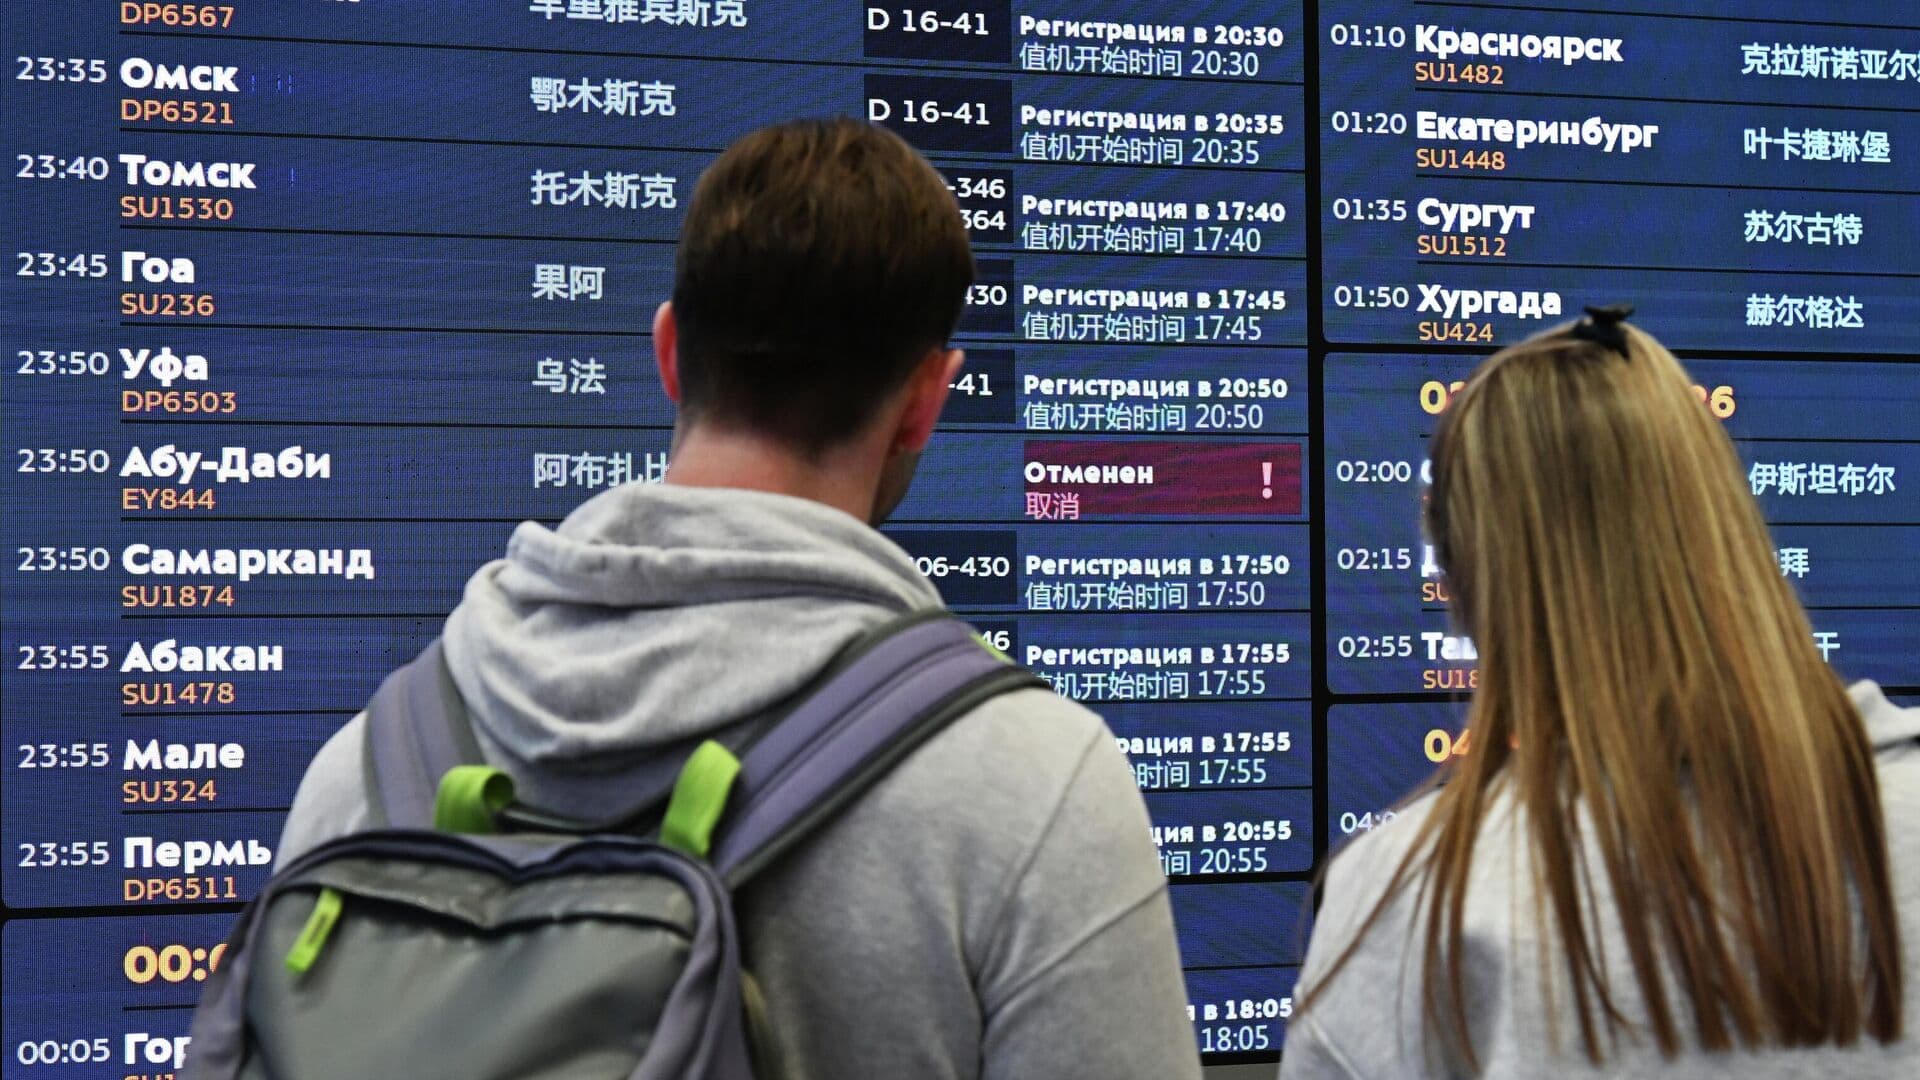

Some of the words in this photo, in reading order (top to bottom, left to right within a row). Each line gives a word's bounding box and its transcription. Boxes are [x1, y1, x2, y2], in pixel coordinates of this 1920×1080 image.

[120, 1, 235, 28] DP6567
[867, 7, 890, 31] D
[902, 9, 989, 36] 16-41
[1020, 15, 1186, 46] Регистрация
[1193, 26, 1208, 44] в
[1214, 24, 1284, 47] 20:30
[1330, 23, 1406, 48] 01:10
[1415, 24, 1624, 64] Красноярск
[16, 56, 107, 83] 23:35
[1019, 40, 1182, 77] 值机开始时间
[1190, 49, 1259, 77] 20:30
[1740, 42, 1920, 83] 克拉斯诺亚尔
[119, 57, 240, 93] Омск
[1414, 61, 1504, 85] SU1482
[530, 76, 676, 117] 鄂木斯克
[121, 98, 234, 125] DP6521
[868, 98, 891, 121] D
[903, 99, 990, 125] 16-41
[1021, 104, 1187, 135] Регистрация
[1194, 114, 1209, 132] в
[1215, 112, 1284, 135] 20:35
[1331, 110, 1407, 135] 01:20
[1416, 110, 1659, 152] Екатеринбург
[1743, 126, 1891, 163] 叶卡捷琳堡
[1020, 131, 1183, 165] 值机开始时间
[1191, 137, 1260, 165] 20:35
[1416, 148, 1506, 171] SU1448
[16, 153, 109, 181] 23:40
[119, 153, 257, 189] Томск
[530, 169, 677, 210] 托木斯克
[121, 195, 234, 221] SU1530
[1022, 194, 1188, 223] Регистрация
[1195, 203, 1210, 220] в
[1217, 200, 1286, 223] 17:40
[1332, 198, 1407, 221] 01:35
[1417, 197, 1536, 234] Сургут
[1021, 221, 1185, 254] 值机开始时间
[1193, 226, 1261, 252] 17:40
[1743, 209, 1863, 246] 苏尔古特
[1417, 234, 1506, 257] SU1512
[16, 252, 108, 278] 23:45
[121, 250, 195, 284] Гоа
[531, 263, 606, 301] 果阿
[121, 292, 215, 317] SU236
[1023, 284, 1189, 312] Регистрация
[1196, 291, 1212, 309] в
[1218, 289, 1286, 311] 17:45
[1334, 285, 1410, 308] 01:50
[1416, 283, 1562, 320] Хургада
[1745, 293, 1865, 329] 赫尔格达
[1022, 311, 1185, 343] 值机开始时间
[1194, 315, 1262, 341] 17:45
[1418, 321, 1494, 343] SU424
[17, 350, 110, 376] 23:50
[118, 346, 209, 388] Уфа
[531, 357, 607, 395] 乌法
[1024, 374, 1190, 401] Регистрация
[1197, 380, 1212, 398] в
[1218, 377, 1288, 399] 20:50
[122, 390, 237, 414] DP6503
[1023, 400, 1187, 432] 值机开始时间
[1195, 403, 1264, 429] 20:50
[17, 448, 110, 473] 23:50
[118, 443, 331, 485] Абу-Даби
[1024, 461, 1154, 484] Отменен
[1336, 460, 1412, 483] 02:00
[1748, 461, 1896, 496] 伊斯坦布尔
[122, 487, 217, 510] EY844
[1025, 491, 1080, 520] 取消
[17, 546, 111, 571] 23:50
[122, 543, 375, 582] Самарканд
[909, 556, 1009, 577] 06-430
[1025, 554, 1192, 580] Регистрация
[1199, 558, 1214, 575] в
[1221, 554, 1290, 575] 17:50
[1337, 548, 1412, 570] 02:15
[121, 585, 235, 608] SU1874
[1024, 581, 1188, 610] 值机开始时间
[1197, 580, 1265, 606] 17:50
[17, 645, 109, 670] 23:55
[119, 638, 283, 673] Абакан
[1026, 645, 1192, 670] Регистрация
[1200, 647, 1215, 664] в
[1221, 643, 1290, 664] 17:55
[1338, 635, 1413, 658] 02:55
[121, 682, 235, 705] SU1478
[1198, 669, 1266, 695] 17:55
[123, 738, 245, 771] Мале
[1201, 736, 1216, 753] в
[1222, 731, 1291, 753] 17:55
[18, 743, 110, 769] 23:55
[1199, 758, 1267, 784] 17:55
[123, 779, 217, 803] SU324
[1202, 825, 1217, 843] в
[1223, 820, 1292, 842] 20:55
[18, 841, 110, 868] 23:55
[123, 836, 272, 874] Пермь
[1199, 847, 1268, 874] 20:55
[124, 876, 238, 901] DP6511
[1203, 1003, 1219, 1021] в
[1225, 998, 1293, 1020] 18:05
[17, 1037, 111, 1065] 00:05
[1201, 1024, 1269, 1052] 18:05
